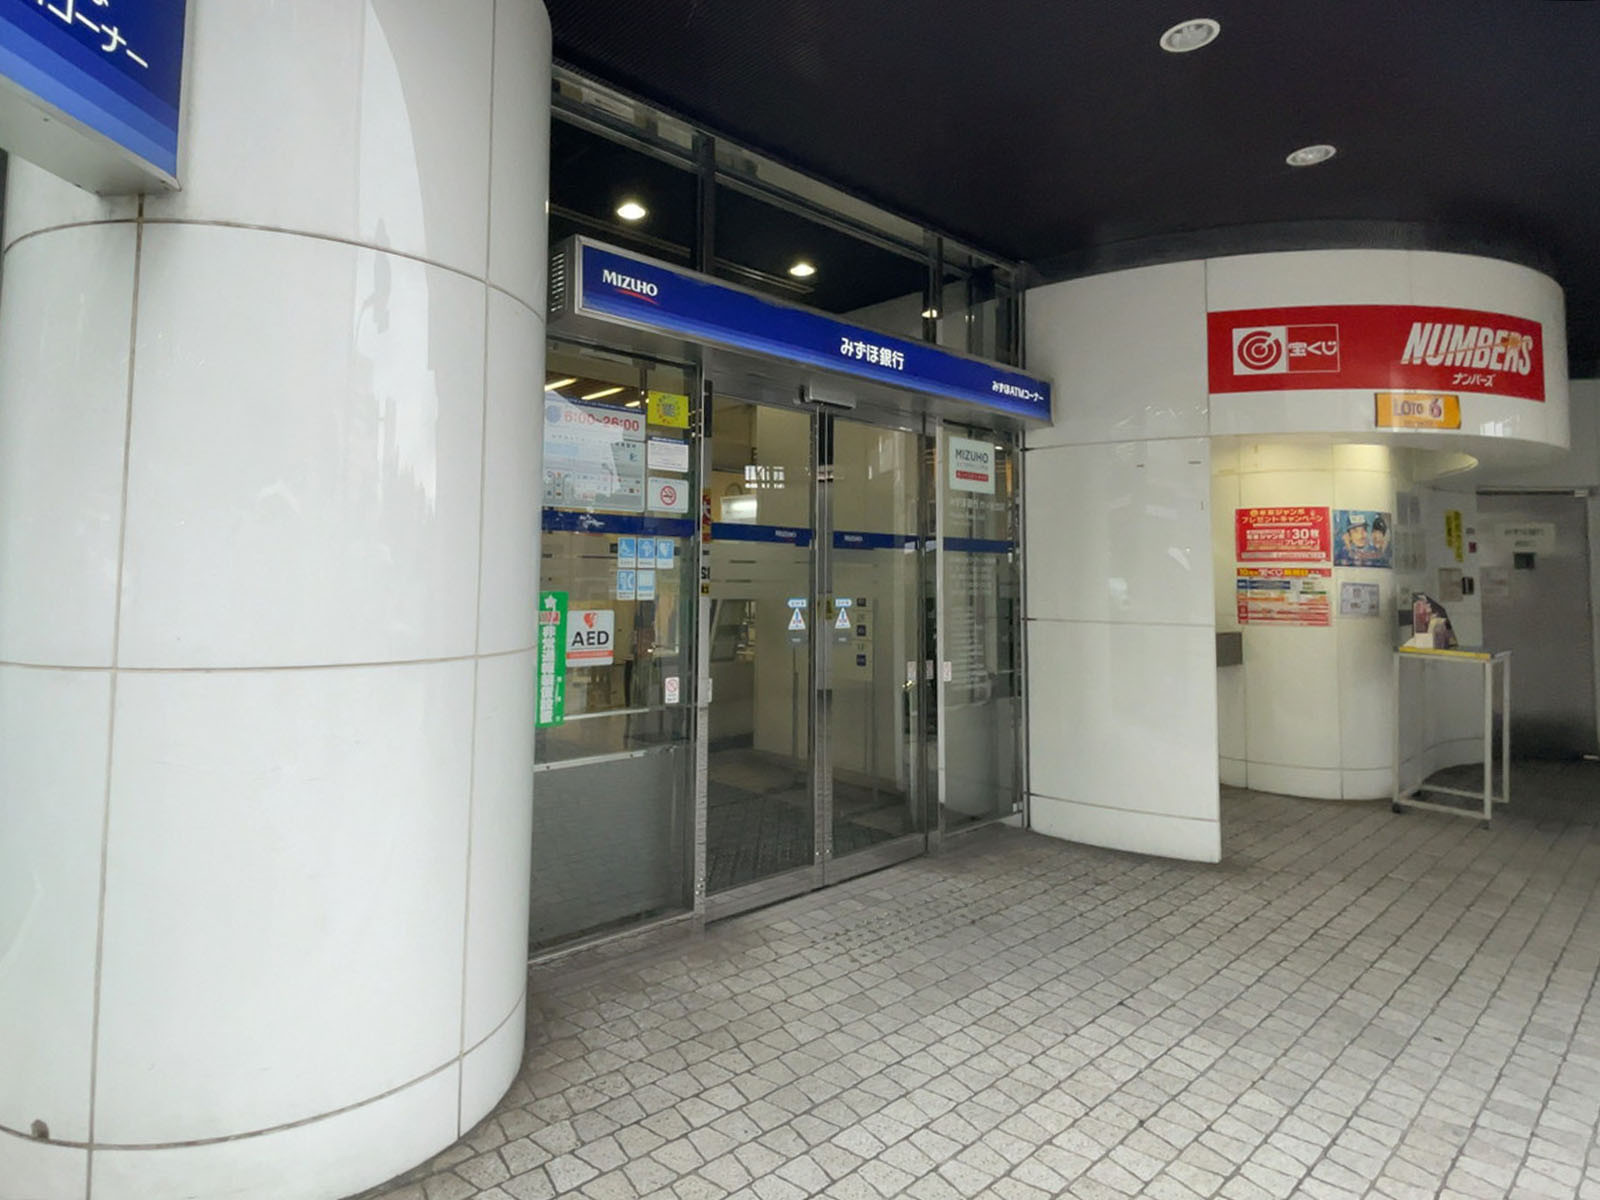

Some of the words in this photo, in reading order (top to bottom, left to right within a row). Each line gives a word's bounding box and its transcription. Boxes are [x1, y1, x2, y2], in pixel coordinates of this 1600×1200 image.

[38, 0, 149, 69] コーナー
[602, 269, 659, 297] MIZUHO
[840, 337, 905, 371] みずほ銀行
[1288, 340, 1338, 357] 宝くじ
[1400, 322, 1534, 376] NUMBERS
[1452, 372, 1497, 387] ナンバーズ
[991, 380, 1045, 402] みずほATMコーナー
[1393, 399, 1424, 416] LOTO
[1429, 397, 1443, 418] 6
[955, 448, 990, 464] MIZUHO
[571, 630, 610, 647] AED
